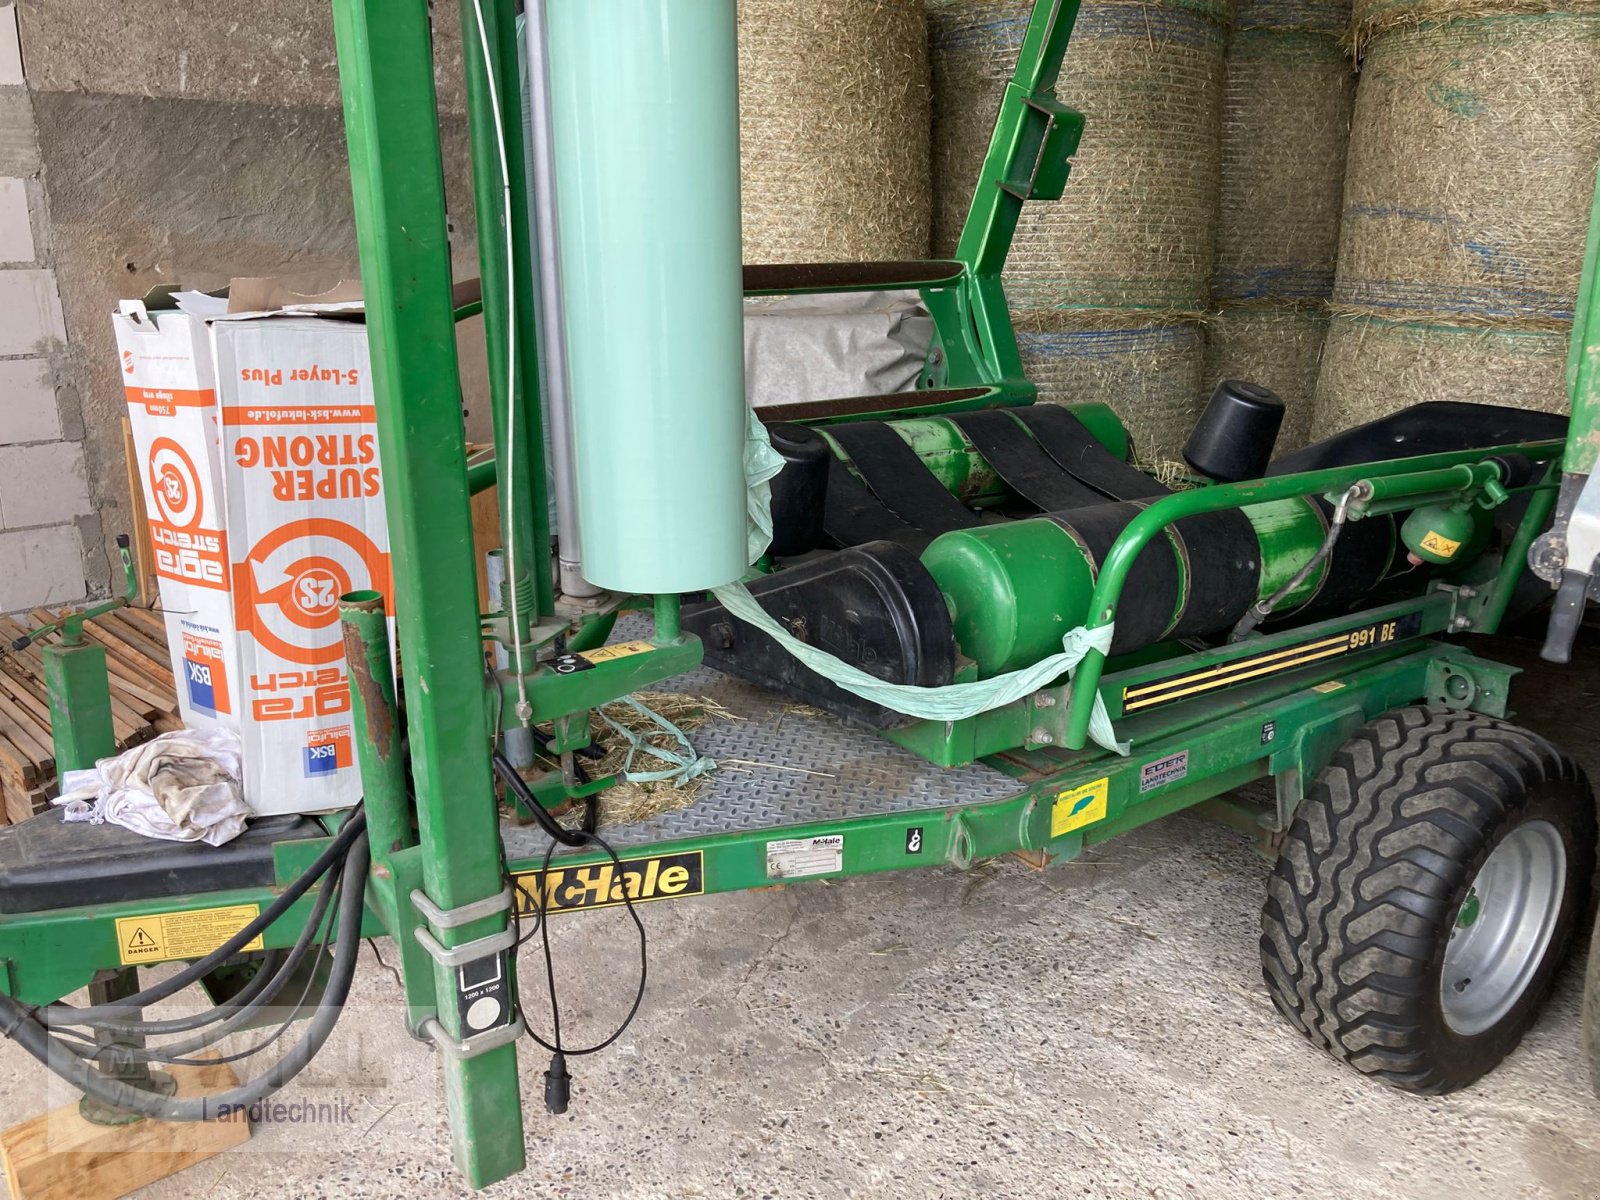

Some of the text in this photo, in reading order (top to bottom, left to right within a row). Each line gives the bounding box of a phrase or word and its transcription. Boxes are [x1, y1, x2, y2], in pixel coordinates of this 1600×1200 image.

[241, 364, 359, 386] 5-Layer Plus
[247, 408, 361, 422] www.bsk-lakufol.de
[234, 433, 375, 468] STRONG
[271, 467, 380, 502] SUPER
[152, 526, 220, 553] stretch
[156, 549, 224, 584] agra
[299, 577, 336, 609] 2S
[1349, 622, 1396, 649] 991 BE
[188, 660, 213, 687] BSK
[250, 667, 348, 692] retch
[252, 683, 350, 722] gra
[310, 744, 336, 760] BSK
[1144, 754, 1186, 776] EDER
[1141, 765, 1187, 786] LANDTECHNIK
[514, 859, 690, 913] McHale
[127, 946, 160, 955] DANGER
[464, 991, 479, 1000] 1200
[485, 984, 500, 993] 1200
